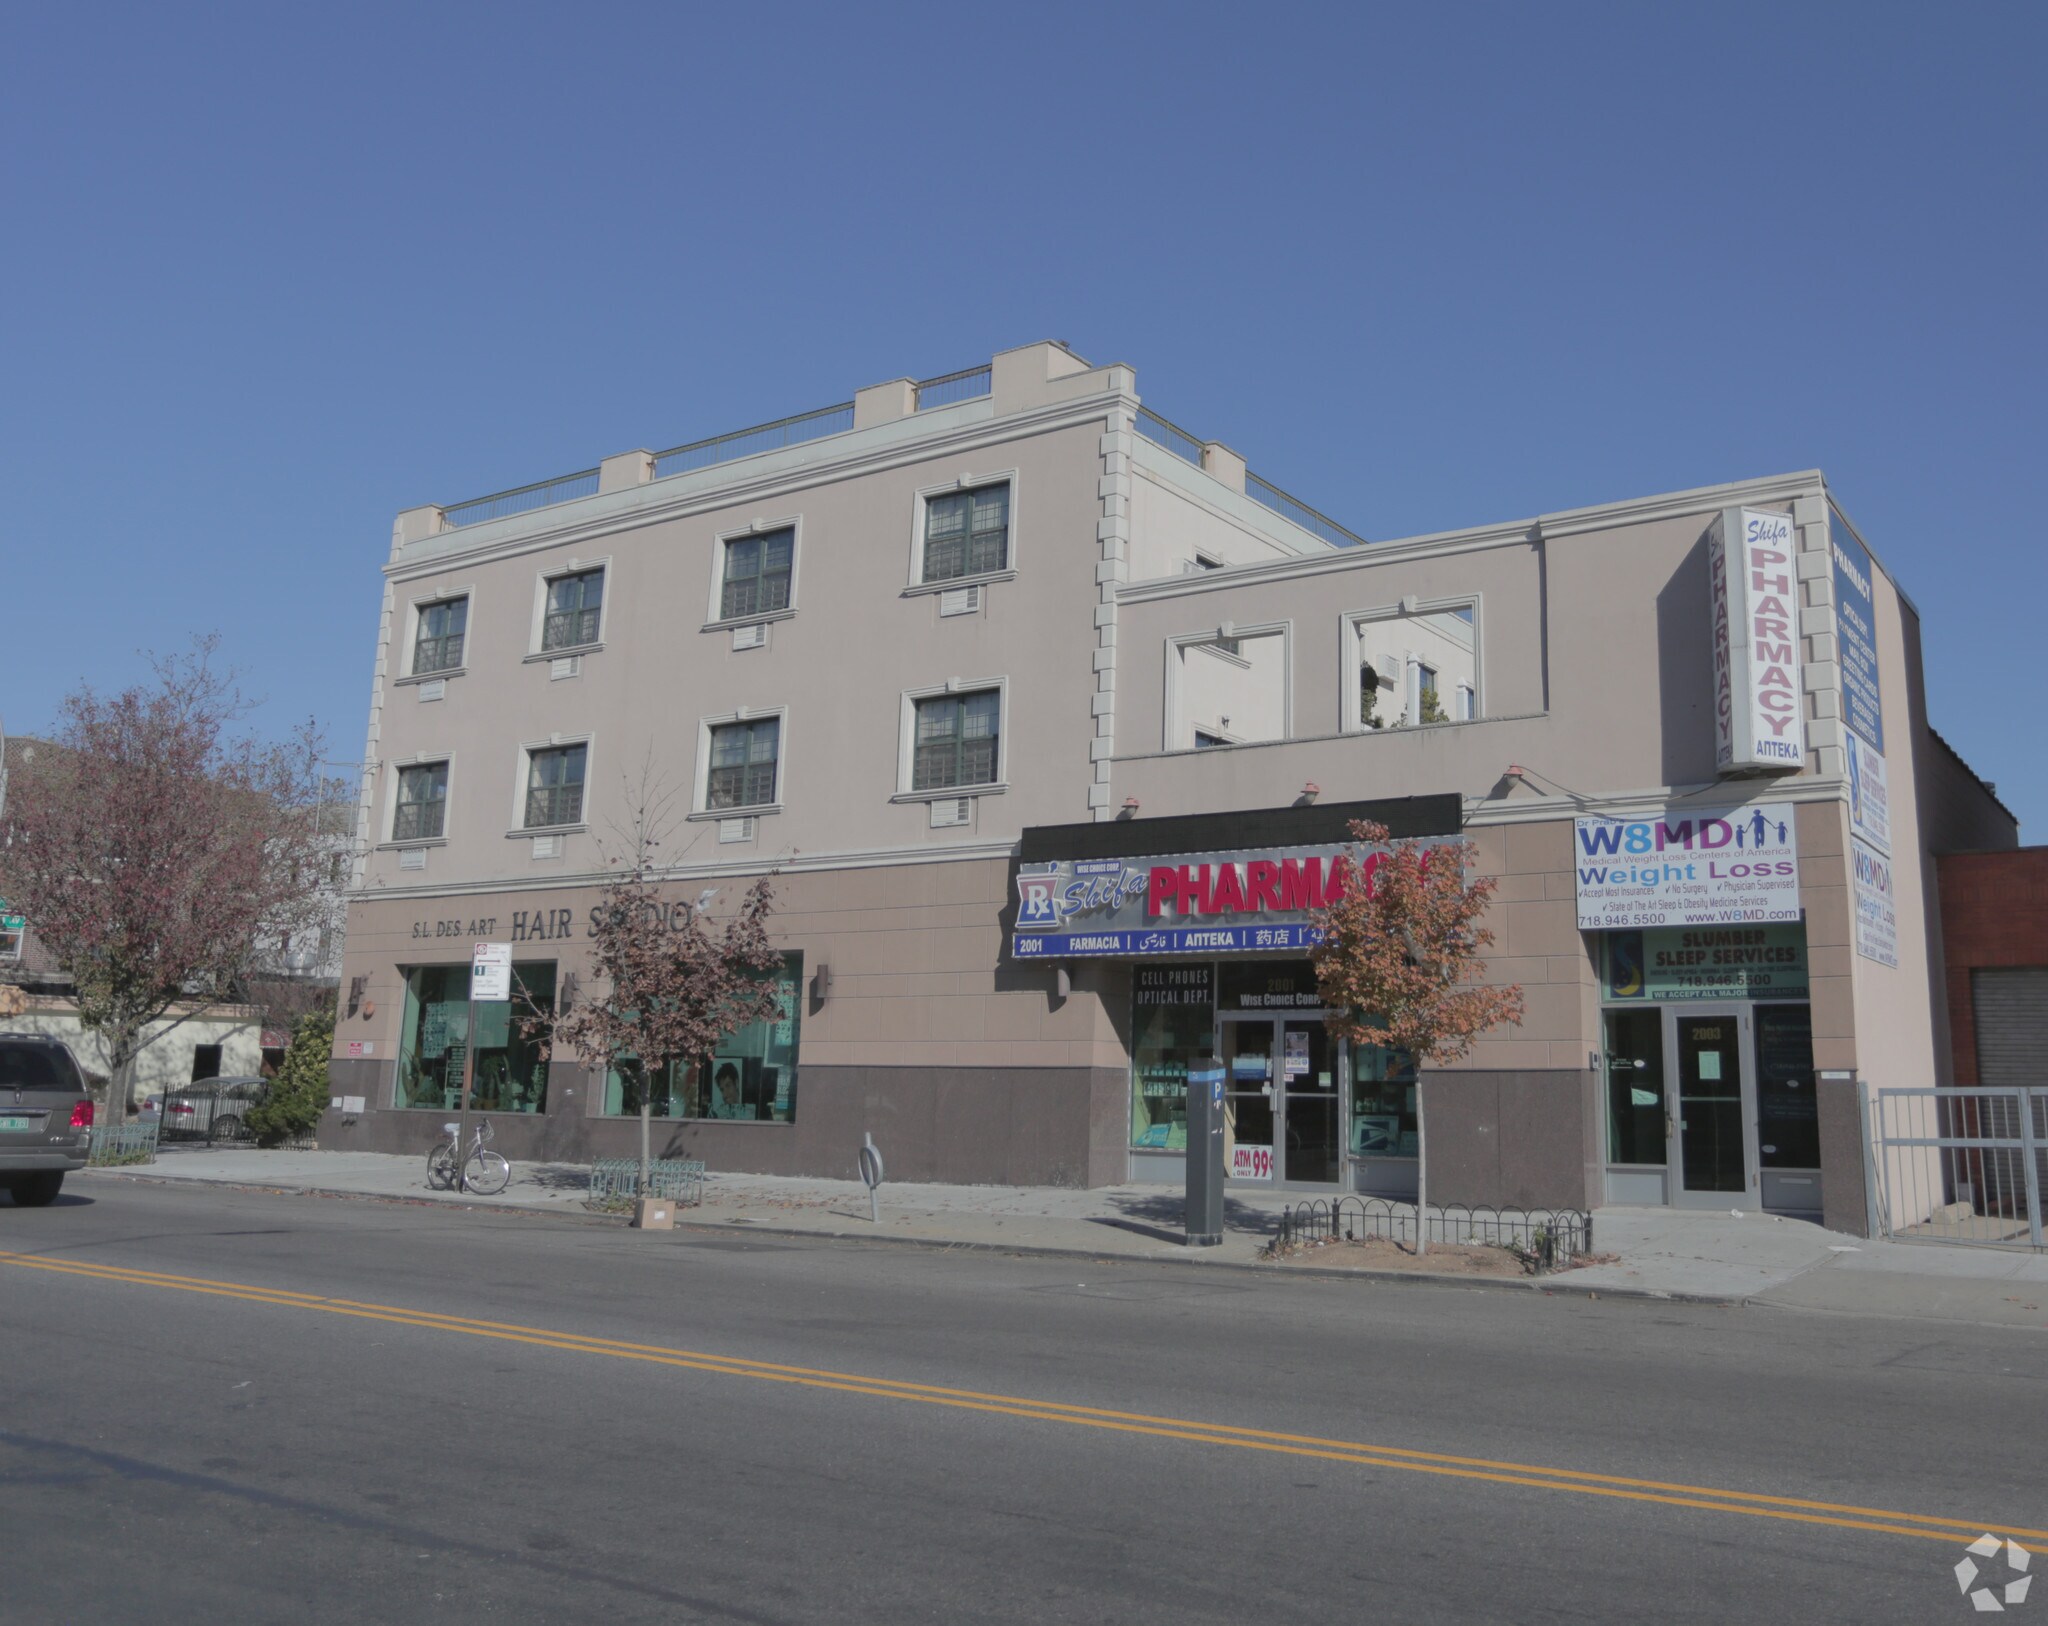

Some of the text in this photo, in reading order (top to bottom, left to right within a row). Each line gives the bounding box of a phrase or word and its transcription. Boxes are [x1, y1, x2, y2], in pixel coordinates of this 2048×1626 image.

[1747, 520, 1788, 546] Shifa
[1833, 542, 1870, 603] PHARMACY
[1712, 553, 1731, 740] PHARMACY
[1751, 548, 1794, 736] PHARMACY
[1756, 740, 1799, 759] АПТЕКА
[1578, 818, 1733, 856] W8MD
[1583, 857, 1621, 866] Medical
[1624, 855, 1659, 865] Weight
[1689, 851, 1731, 860] Centers
[1734, 849, 1744, 857] of
[1747, 848, 1791, 856] America
[1089, 863, 1106, 873] CHOICE
[1578, 861, 1794, 886] Weight Loss
[1853, 847, 1884, 892] W8MD
[1060, 867, 1148, 916] Shifa
[1583, 887, 1655, 898] Accept Most Insurances
[1672, 883, 1708, 895] No Surgery
[1724, 878, 1795, 893] Physician Supervised
[1609, 902, 1625, 912] State
[1627, 902, 1633, 911] of
[1634, 901, 1646, 910] The
[1648, 901, 1657, 910] Art
[1658, 900, 1676, 910] Sleep
[1684, 897, 1708, 910] Obesity
[1709, 896, 1738, 907] Medicine
[1740, 895, 1768, 906] Services
[1855, 890, 1881, 922] Weight
[1882, 903, 1894, 926] Loss
[412, 922, 432, 938] S.L.
[436, 920, 463, 937] DES.
[467, 918, 497, 936] ART
[511, 908, 573, 941] HAIR
[1578, 909, 1797, 926] 718.946.5500 www.W8MD.com
[1020, 935, 1120, 953] 2001 FARMACIA
[1185, 932, 1234, 946] АПТЕКА
[1255, 929, 1289, 946] 药店
[1683, 930, 1766, 947] SLUMBER
[1655, 947, 1796, 967] SLEEP SERVICES
[1142, 970, 1209, 986] CELL PHONES
[1267, 978, 1295, 992] 2001
[1678, 974, 1771, 987] 718.946.5500
[1138, 990, 1212, 1005] OPTICAL DEPT.
[1240, 994, 1262, 1006] WISE
[1264, 993, 1295, 1006] CHOICE
[1719, 989, 1748, 997] MAJOR
[1692, 1027, 1722, 1041] 2003
[1214, 1082, 1221, 1098] P
[1234, 1150, 1251, 1167] ATM
[1237, 1169, 1251, 1177] ONLY
